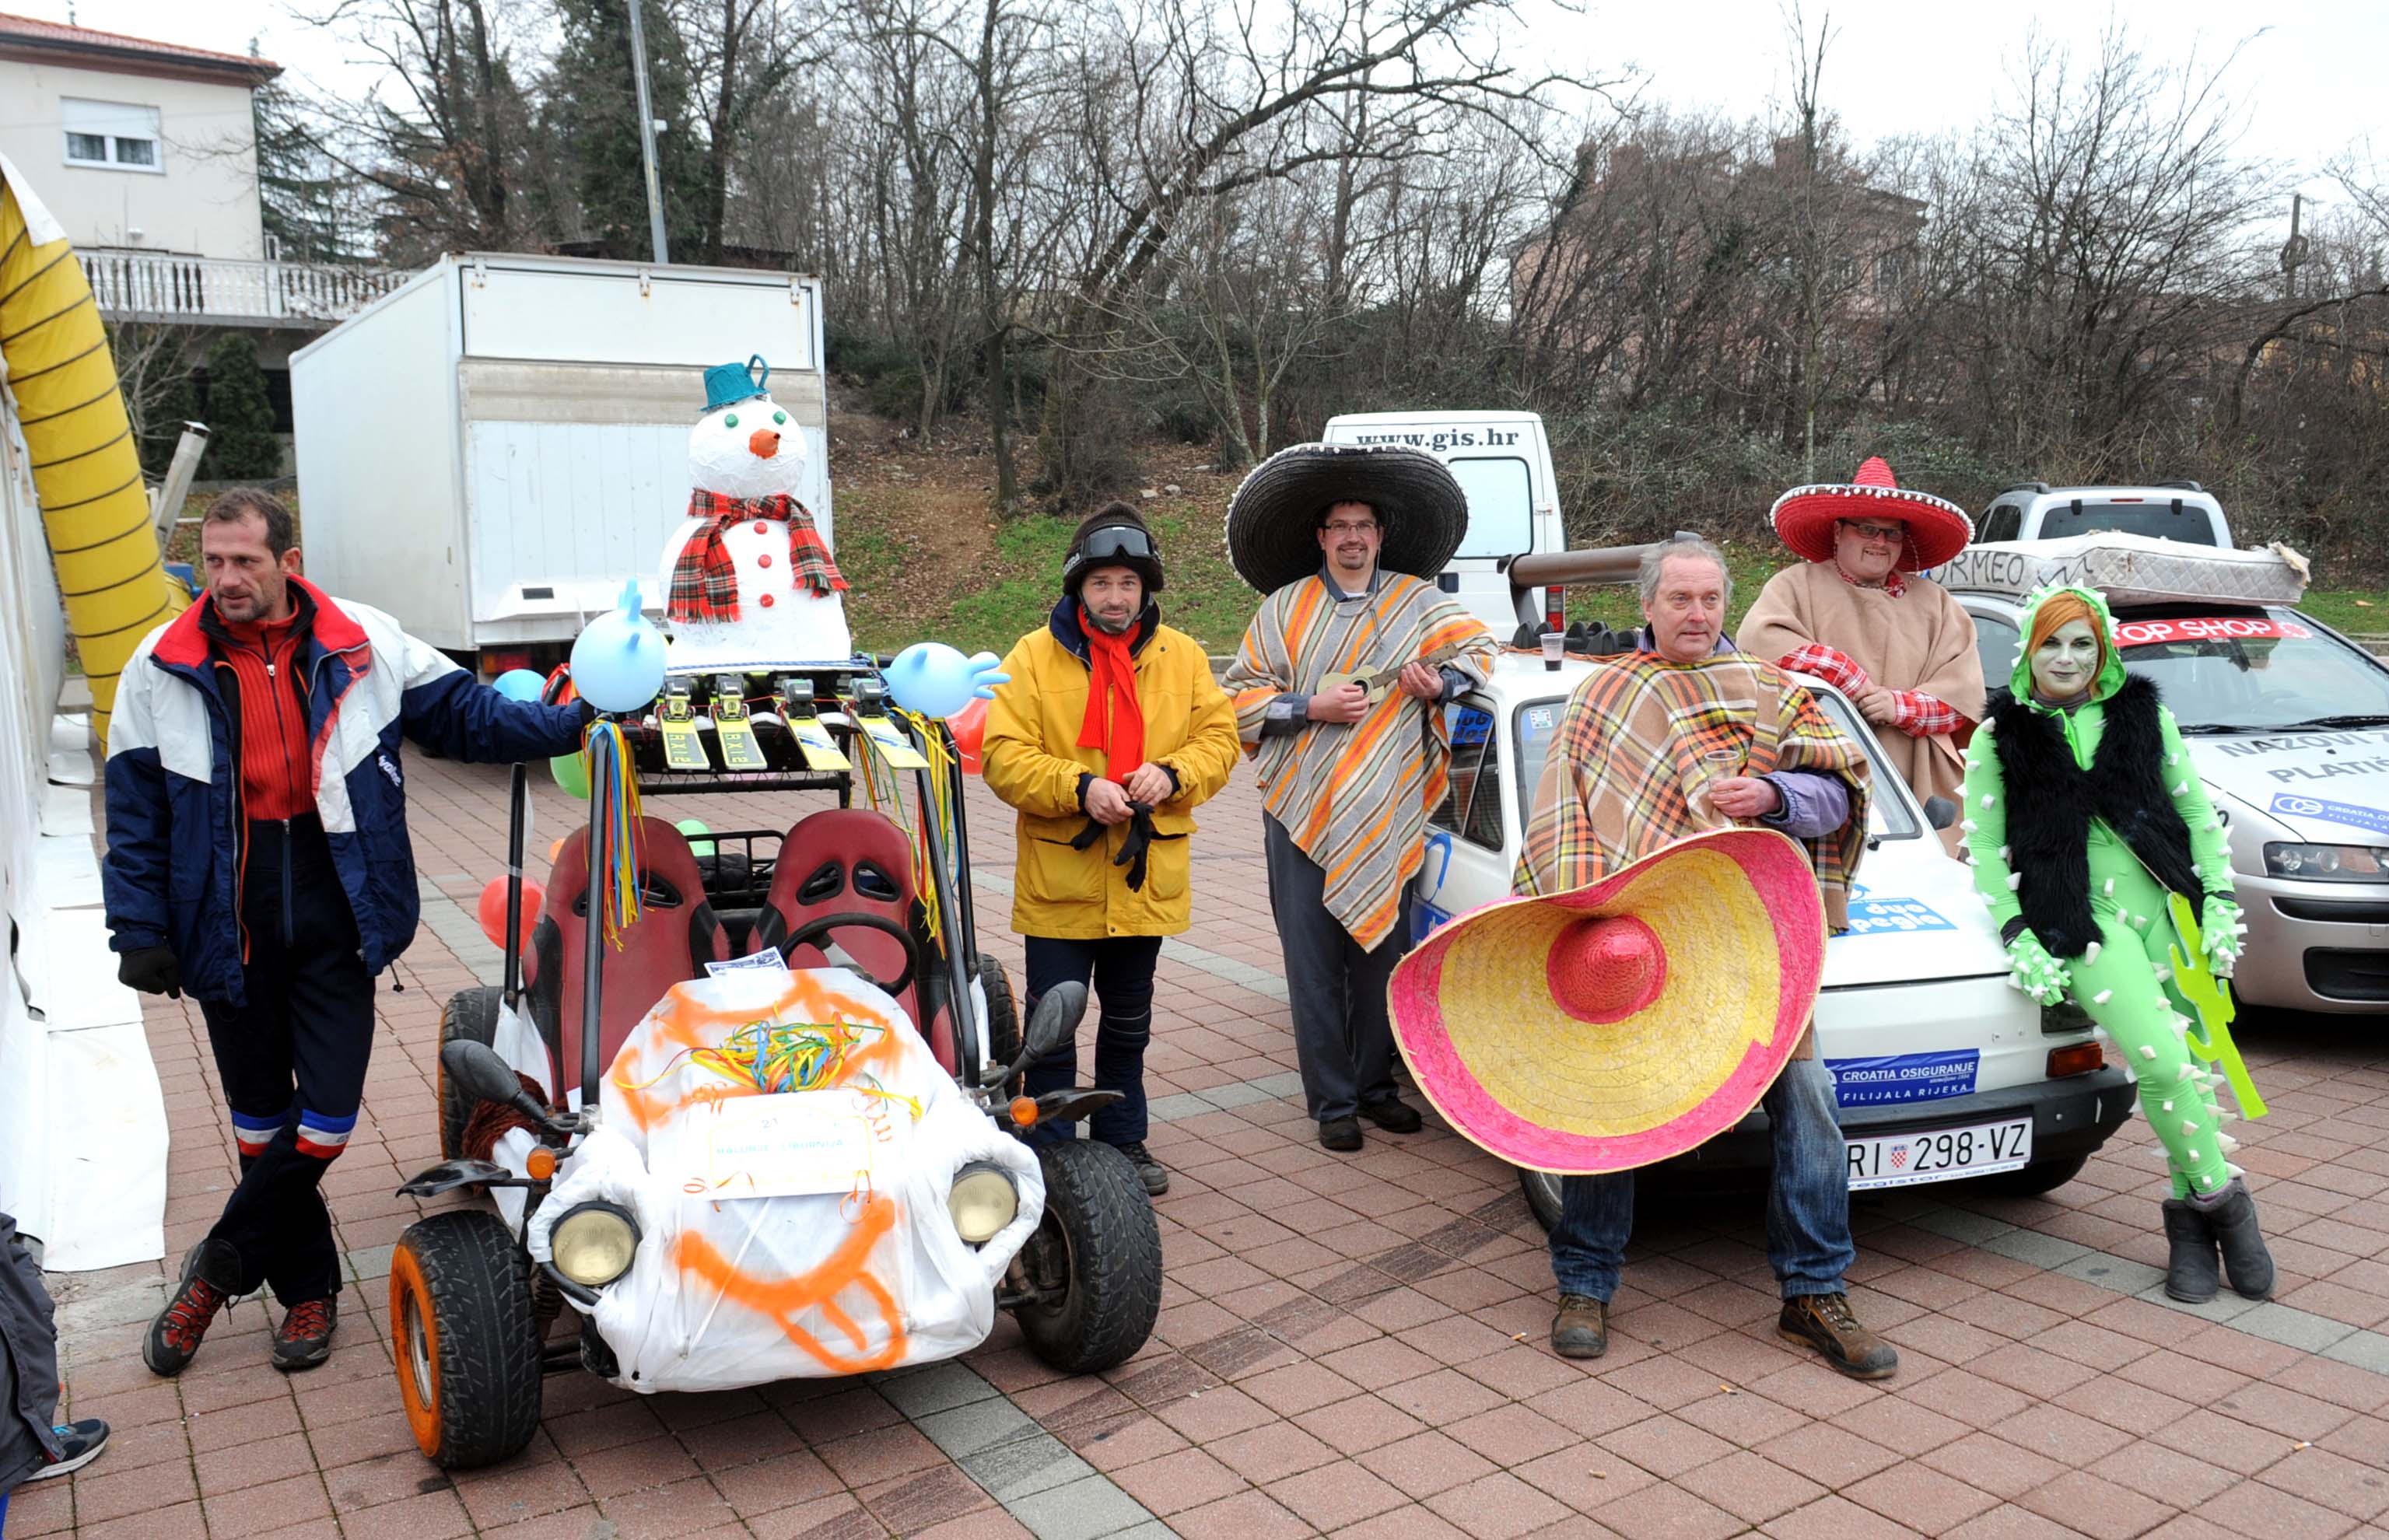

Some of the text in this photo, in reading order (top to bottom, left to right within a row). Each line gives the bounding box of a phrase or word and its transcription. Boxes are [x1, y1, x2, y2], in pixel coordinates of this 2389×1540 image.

[1357, 428, 1519, 452] www.gis.hr
[1928, 550, 2024, 585] ORMEO
[2179, 620, 2272, 636] SHOP
[2216, 733, 2373, 758] NAZOVI
[2328, 805, 2374, 818] CROATIA
[1865, 903, 1927, 915] duo
[1849, 912, 1945, 933] pegla
[1842, 1062, 1975, 1081] CROATIA OSIGURANJE
[1844, 1084, 1967, 1101] FILIJALA RIJEKA
[1848, 1123, 2026, 1177] RI 298-VZ
